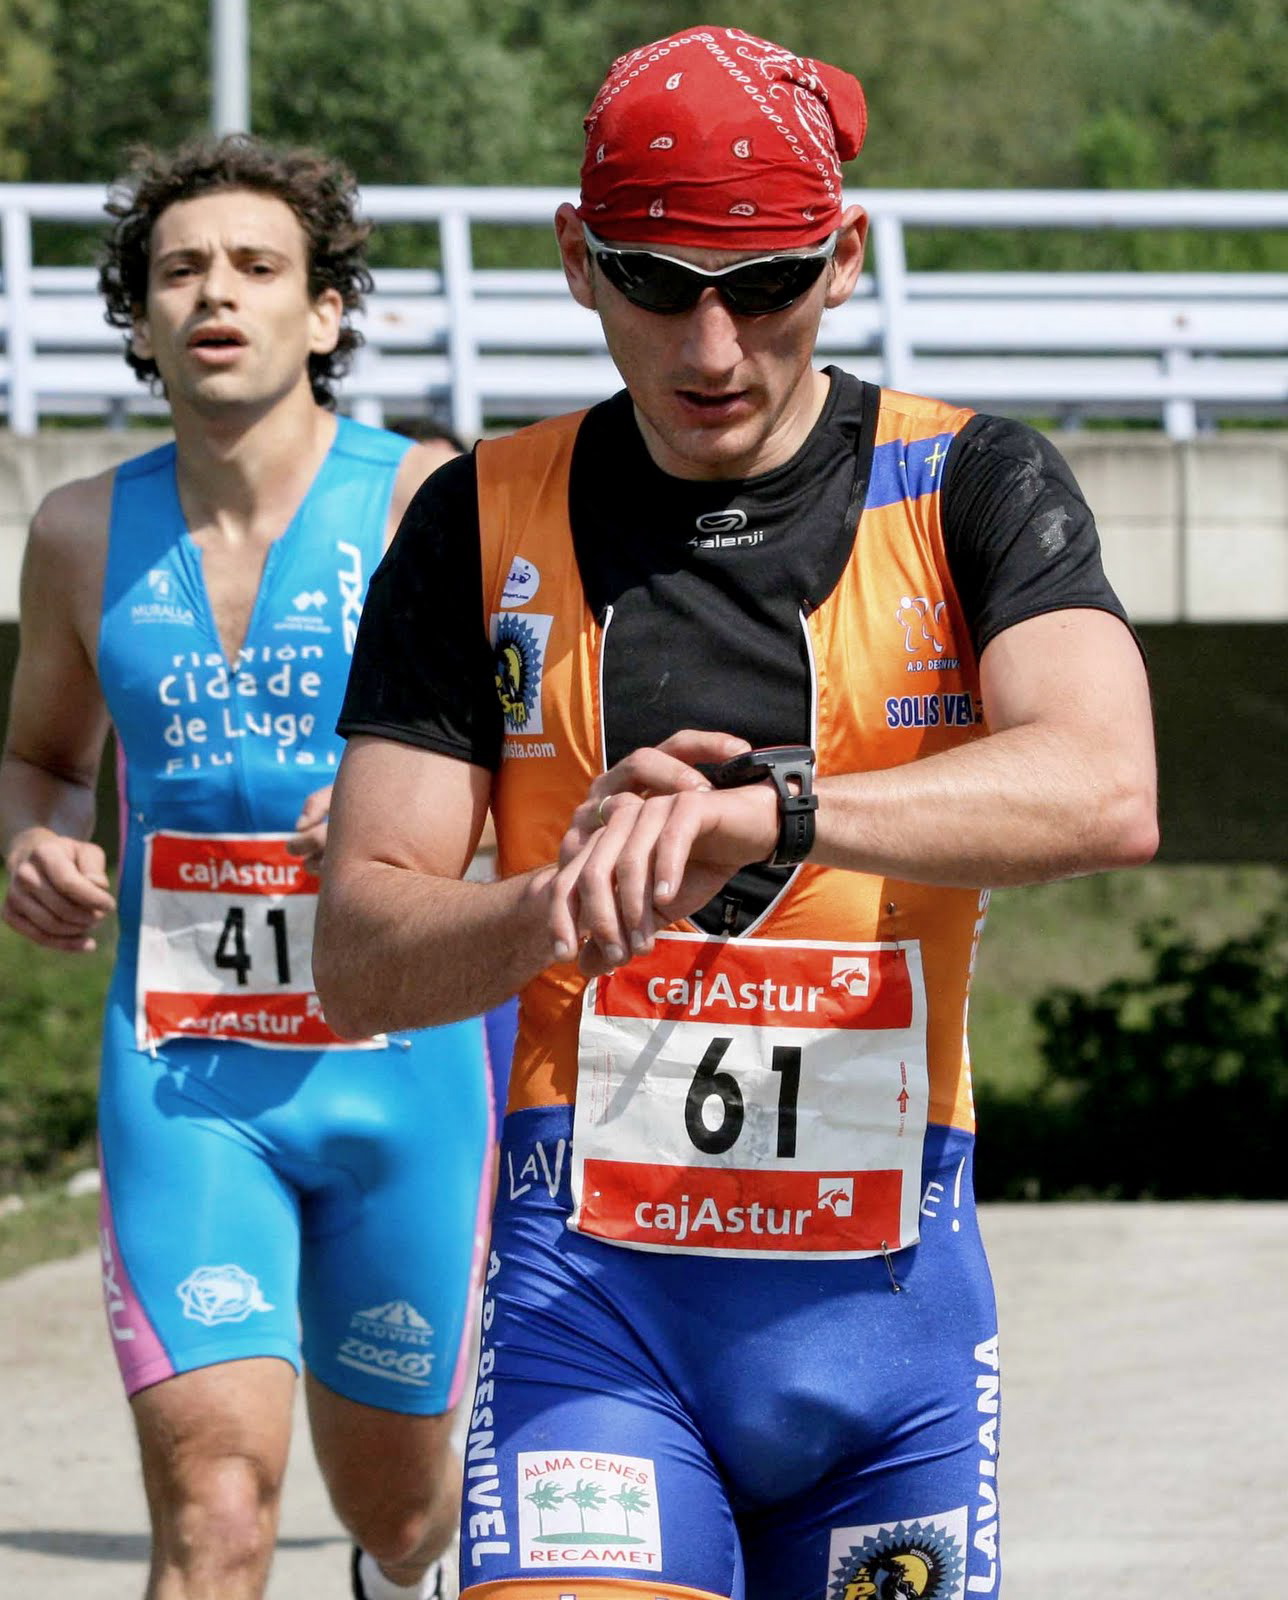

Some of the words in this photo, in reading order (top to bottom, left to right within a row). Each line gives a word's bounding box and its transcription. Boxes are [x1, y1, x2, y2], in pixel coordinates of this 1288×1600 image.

[158, 663, 322, 706] Cidade
[928, 658, 961, 671] DESNIV
[164, 713, 208, 747] de
[886, 693, 940, 730] SOLIS
[178, 859, 300, 888] cajAstur
[215, 906, 291, 985] 41
[647, 969, 824, 1016] cajAstur
[685, 1037, 802, 1158] 61
[507, 1138, 573, 1200] LAV
[635, 1198, 812, 1237] cajAstur
[966, 1333, 999, 1593] LAVIANA
[530, 1549, 656, 1565] RECAMET
